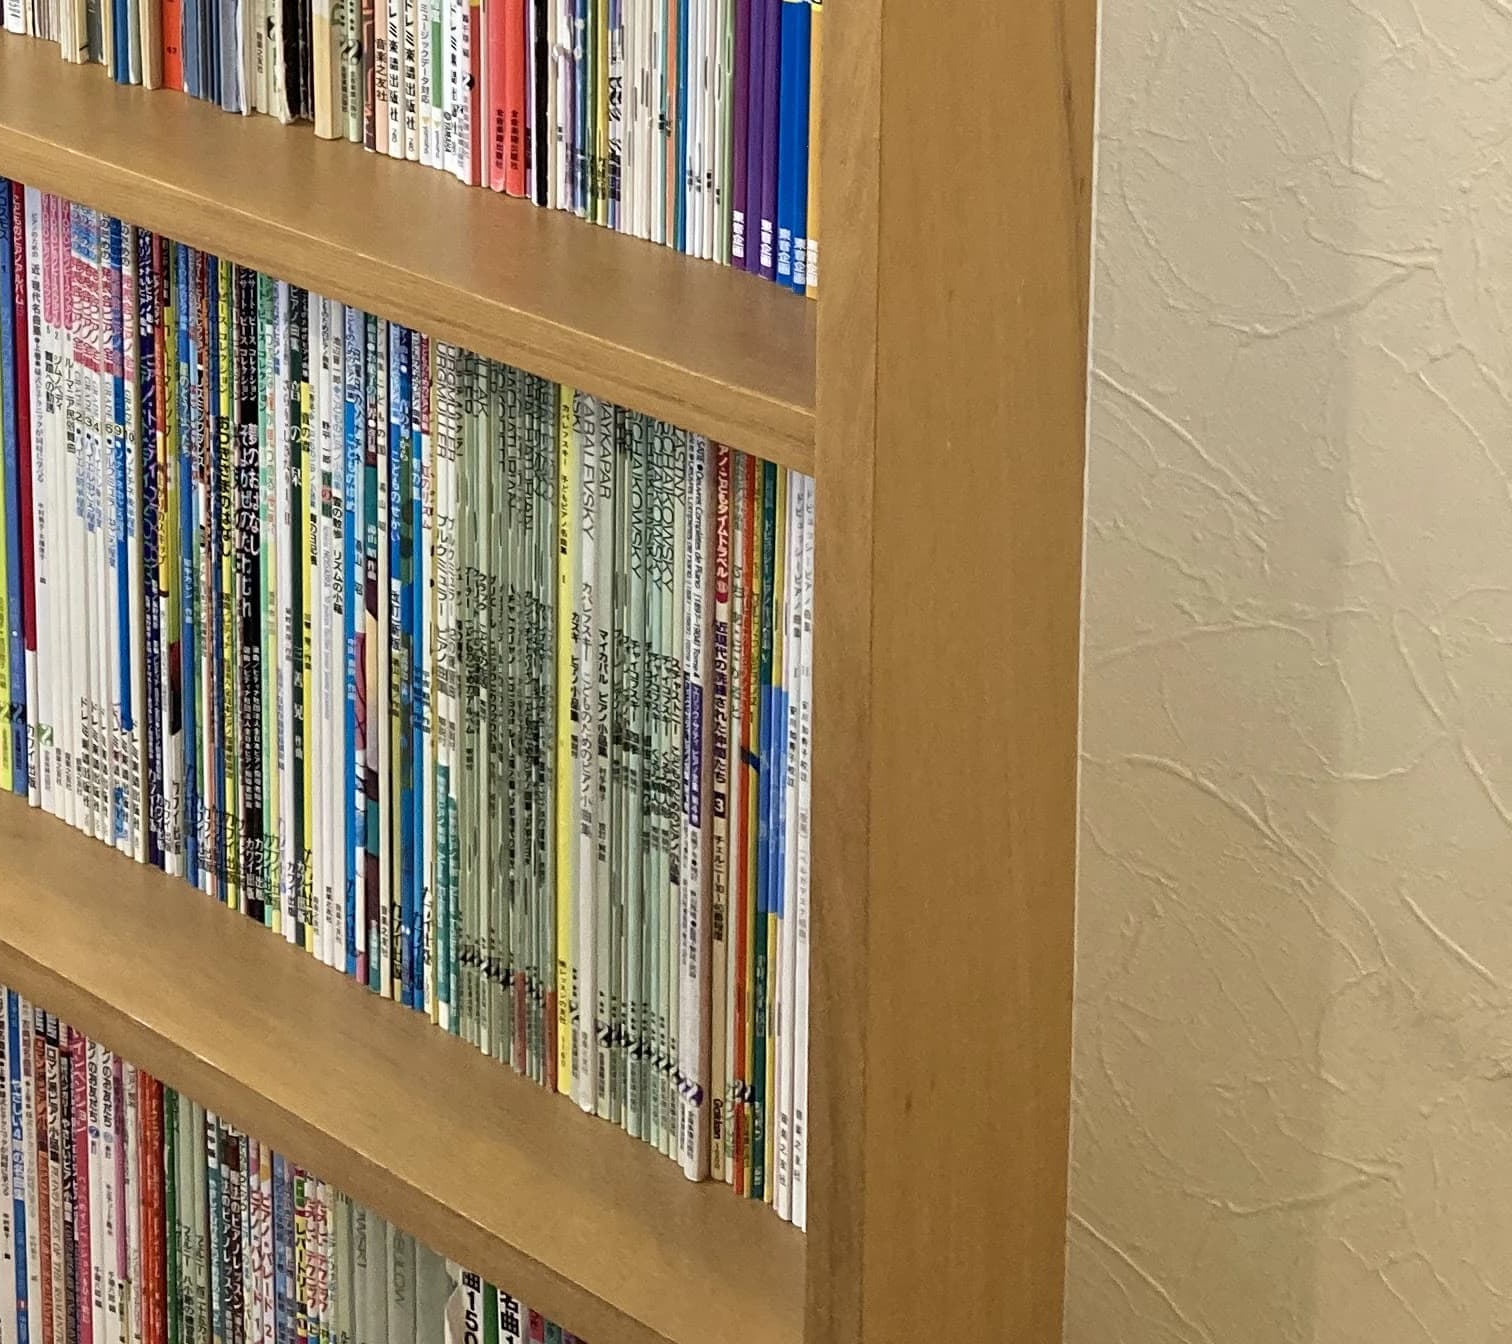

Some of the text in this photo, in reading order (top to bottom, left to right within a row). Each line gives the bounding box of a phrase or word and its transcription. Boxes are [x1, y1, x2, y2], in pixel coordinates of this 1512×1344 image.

[376, 38, 388, 103] 音楽之友社
[248, 423, 261, 556] 夢のおはなし
